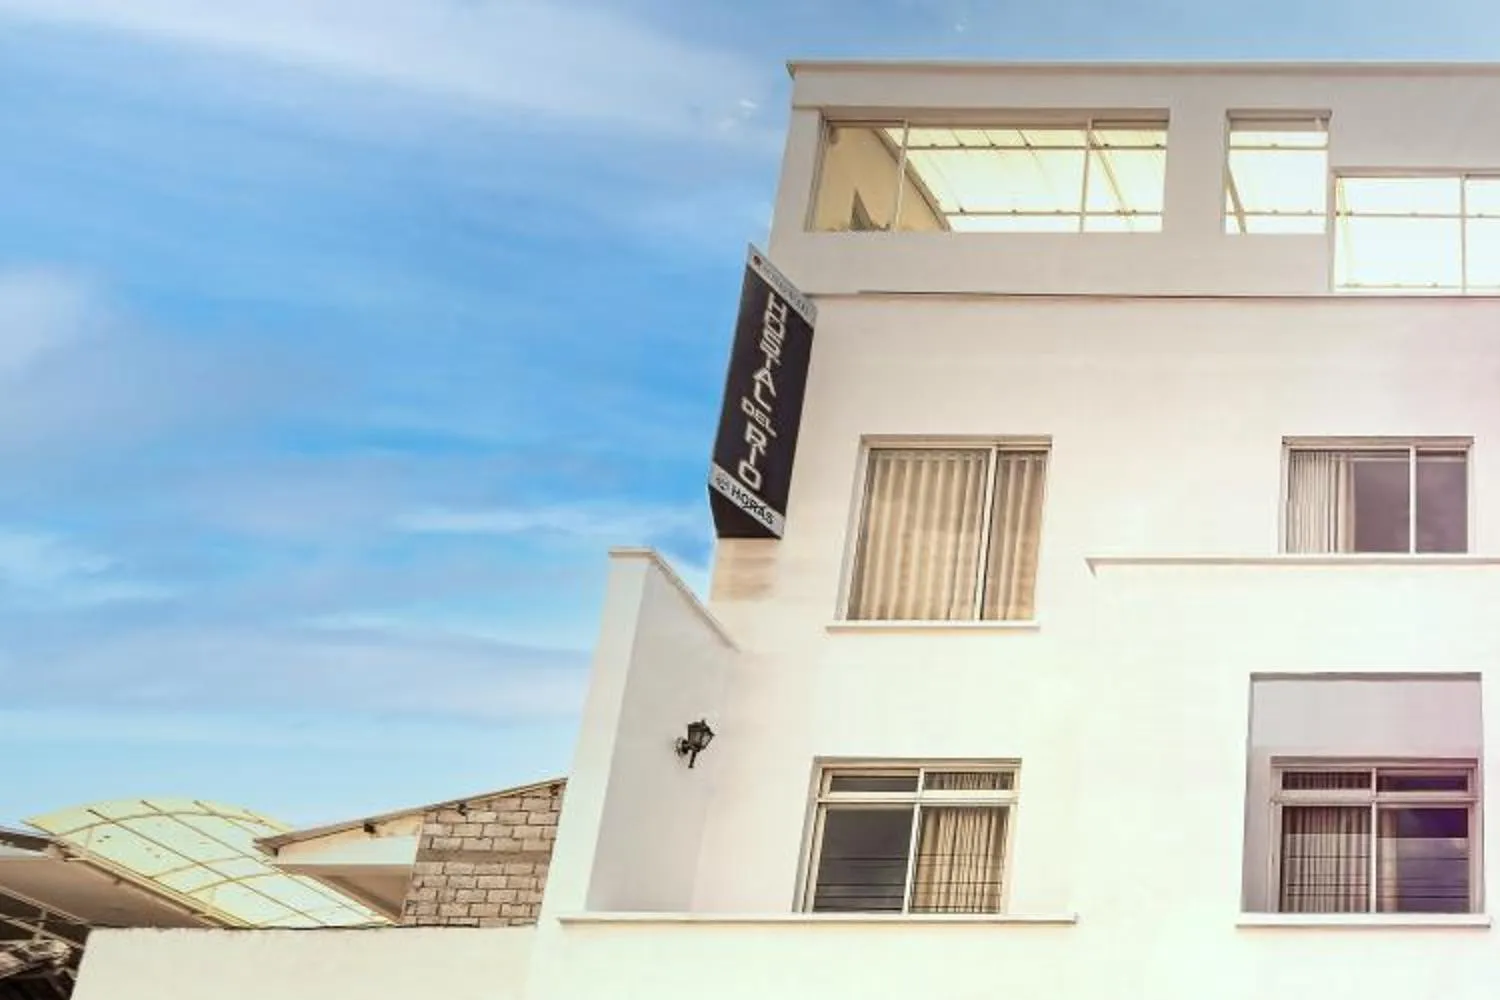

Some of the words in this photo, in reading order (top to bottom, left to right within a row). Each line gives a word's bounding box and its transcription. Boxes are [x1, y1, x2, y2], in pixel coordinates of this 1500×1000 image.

[754, 291, 788, 412] HOSTAL
[741, 396, 777, 438] DEL
[738, 422, 767, 491] RIO
